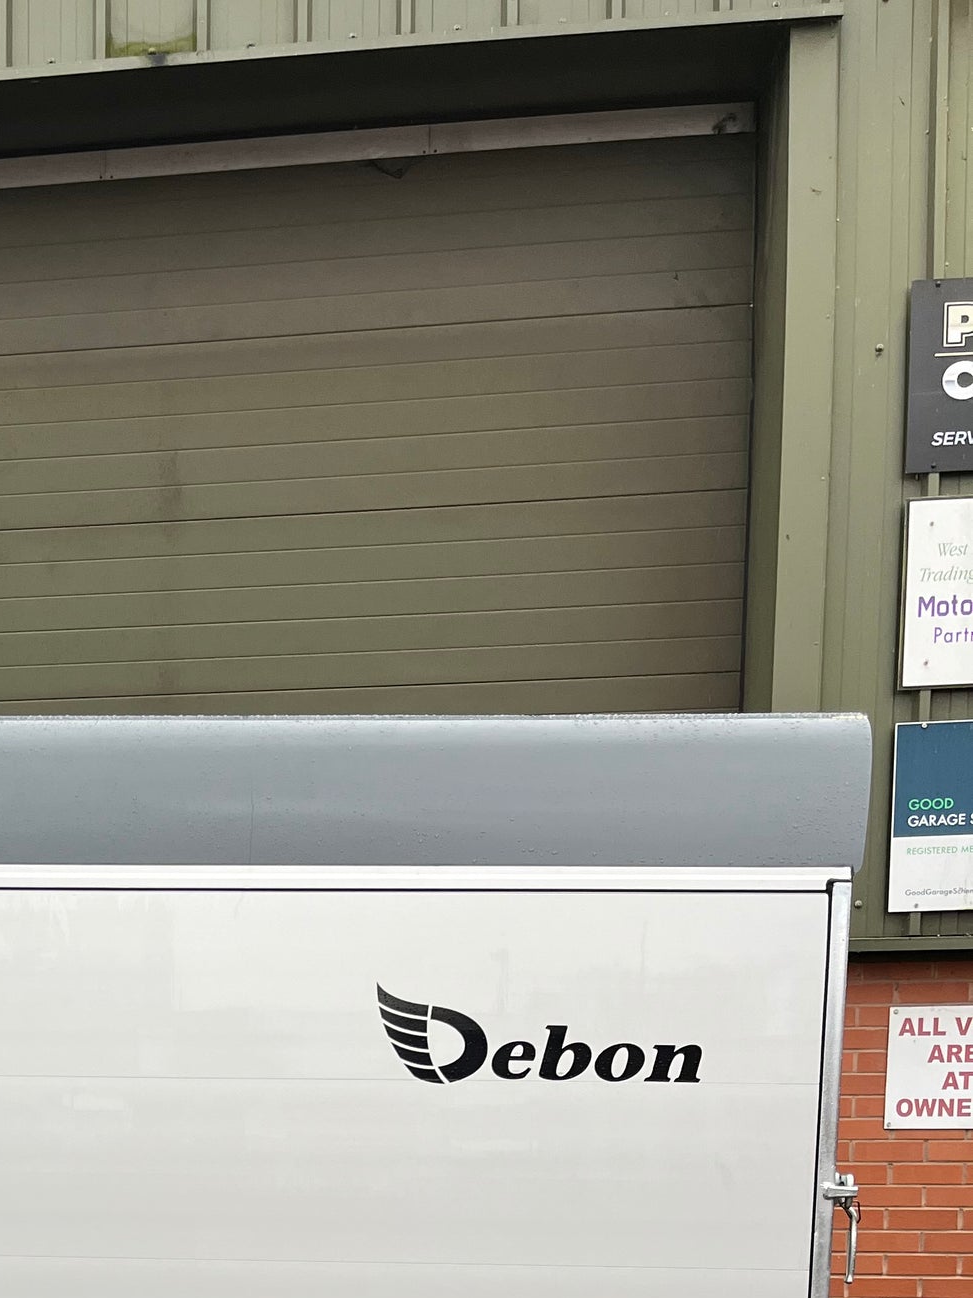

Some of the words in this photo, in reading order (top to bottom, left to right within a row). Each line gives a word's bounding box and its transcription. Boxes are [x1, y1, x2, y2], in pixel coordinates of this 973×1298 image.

[938, 543, 968, 556] West
[908, 798, 954, 811] GOOD
[907, 813, 966, 827] GARAGE
[906, 846, 958, 856] REGISTERED
[377, 982, 702, 1084] Debon
[898, 1017, 946, 1036] ALL
[955, 1017, 973, 1036] V
[927, 1044, 973, 1063] ARE
[941, 1071, 973, 1090] AT
[895, 1098, 972, 1117] OWNE
